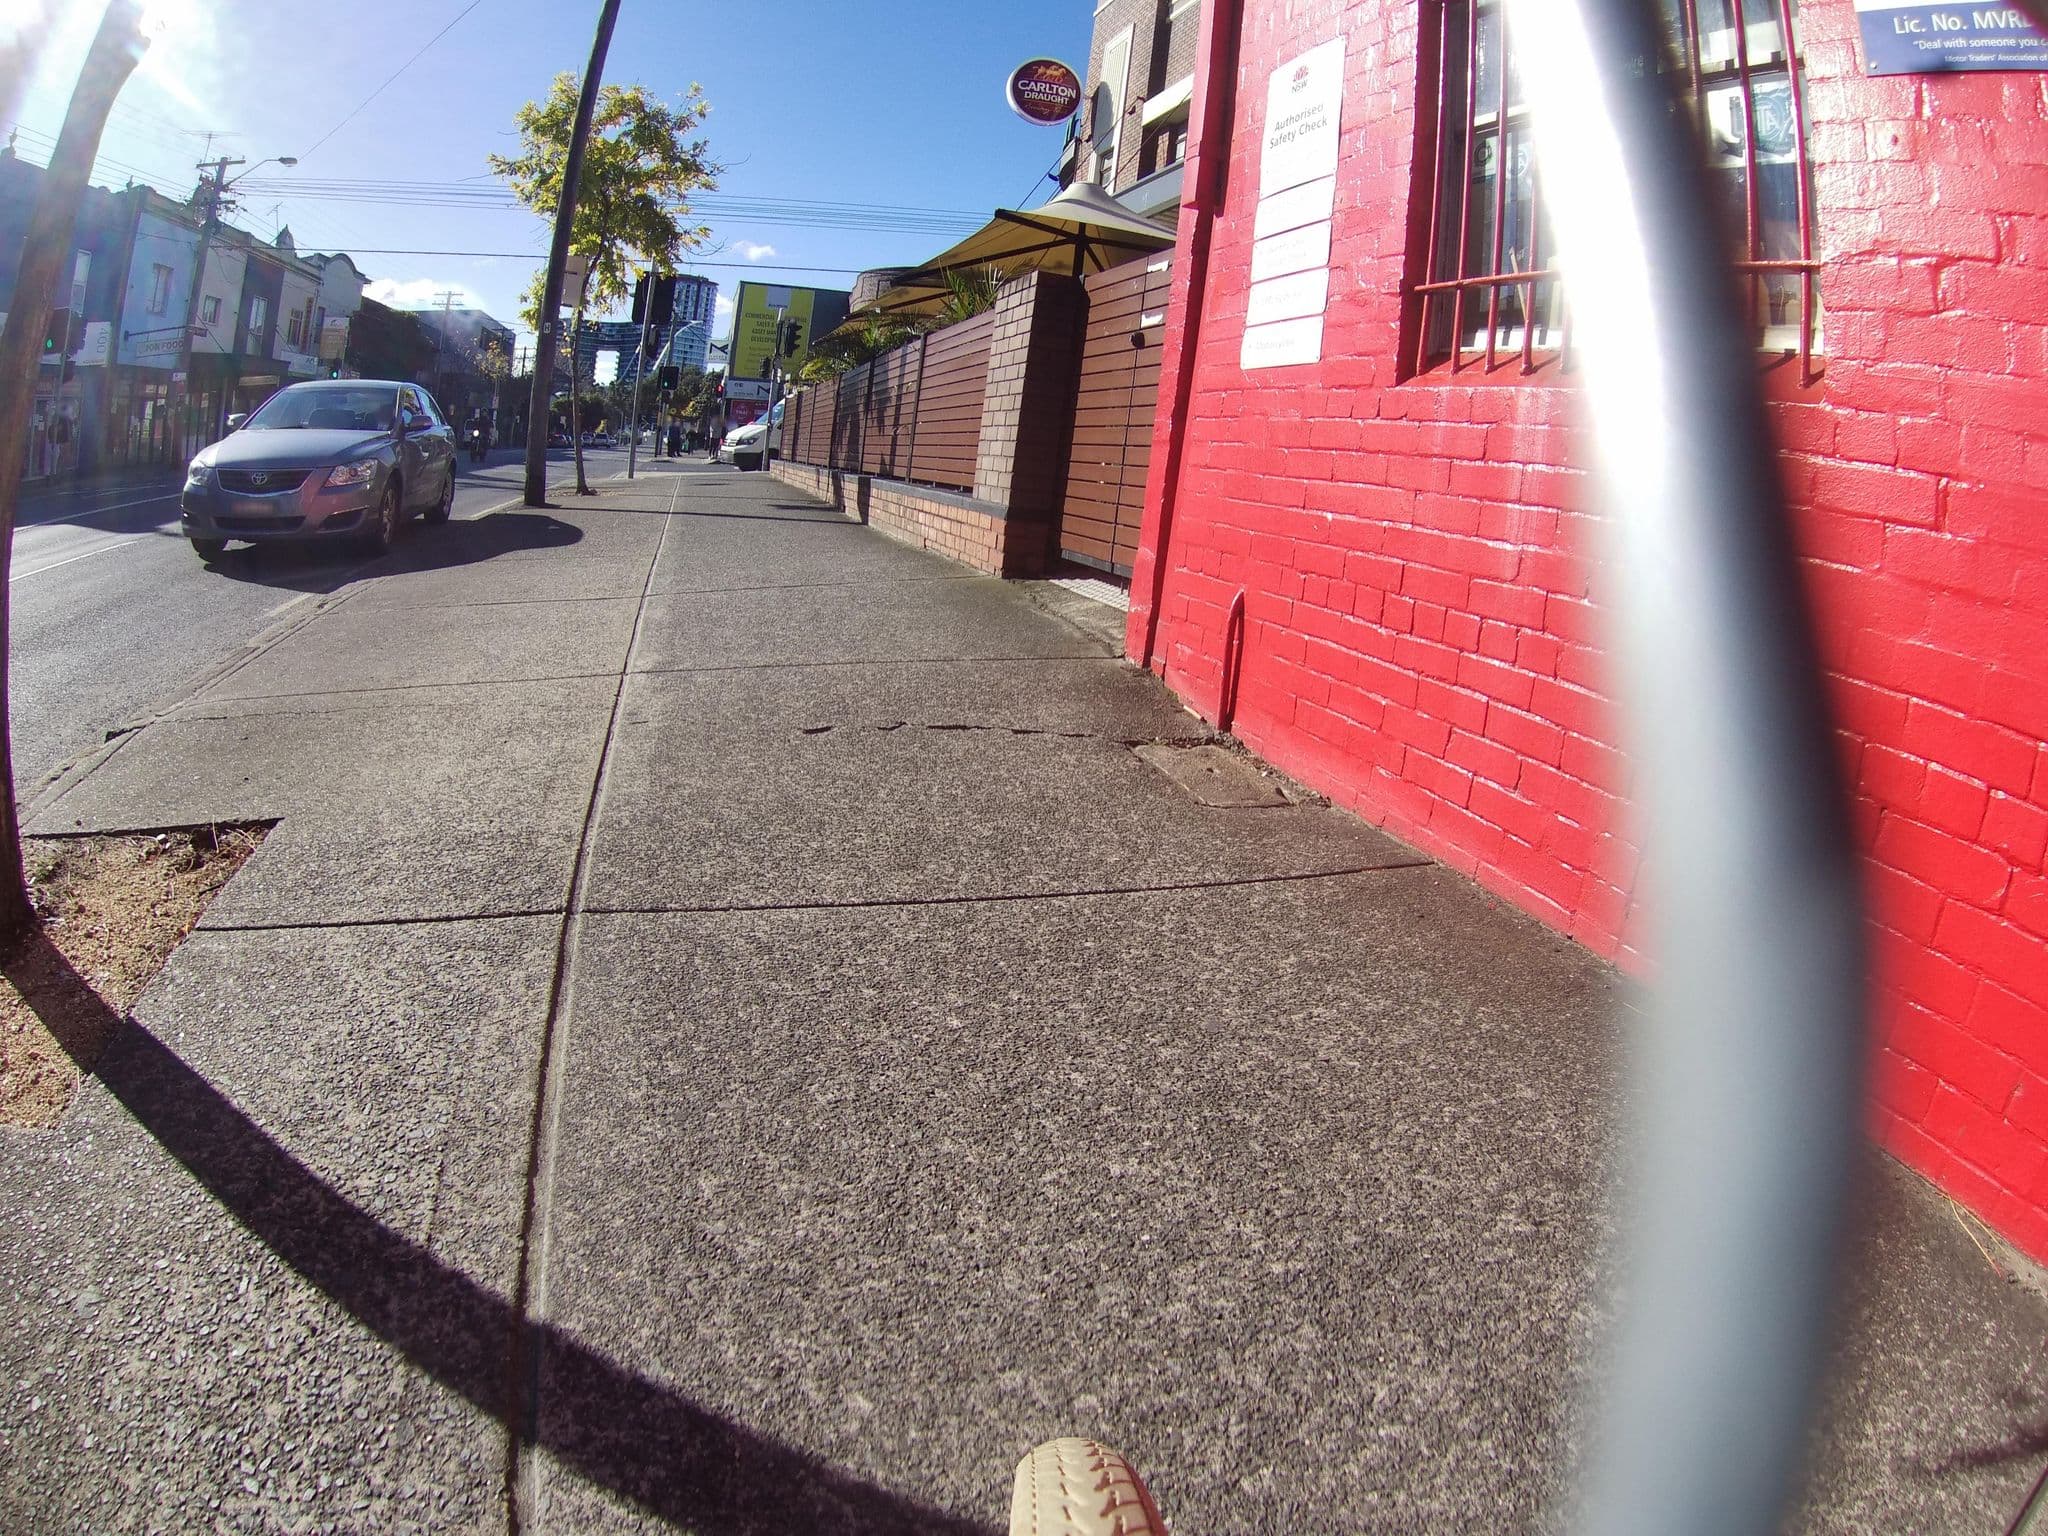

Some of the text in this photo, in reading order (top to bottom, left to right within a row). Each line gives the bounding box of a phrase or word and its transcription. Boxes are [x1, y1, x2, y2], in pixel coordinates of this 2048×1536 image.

[1892, 15, 1926, 35] Lic.
[1931, 12, 1967, 32] No.
[1944, 37, 1967, 49] with
[1968, 38, 2016, 48] someone
[2018, 38, 2039, 49] you
[1998, 53, 2038, 62] Association
[1018, 80, 1077, 98] CARLTON
[1291, 79, 1308, 94] NSW
[1024, 91, 1069, 104] DRAUGHT
[1274, 101, 1324, 132] Authorised
[1269, 116, 1328, 150] Safety Check
